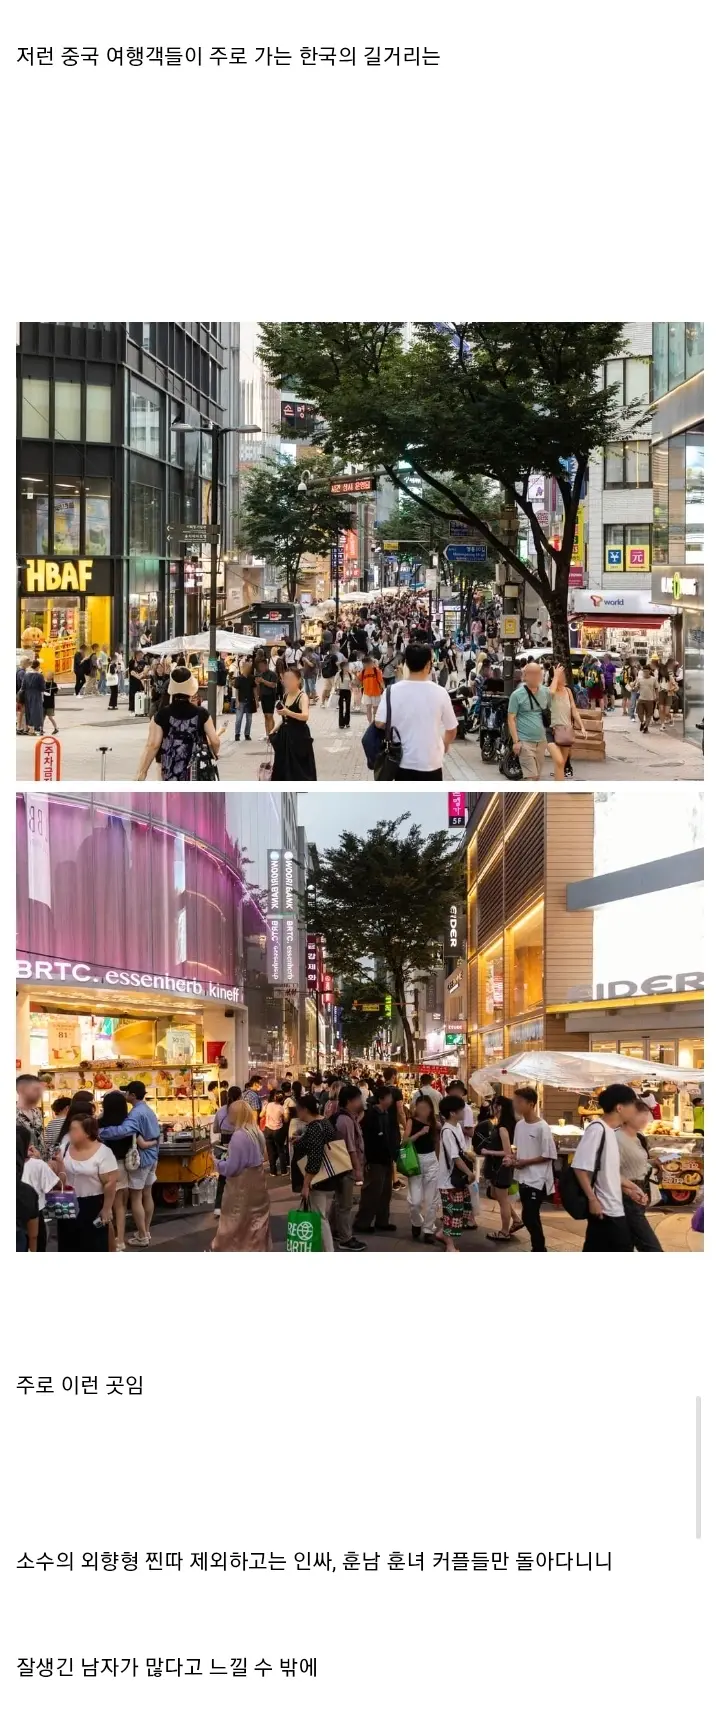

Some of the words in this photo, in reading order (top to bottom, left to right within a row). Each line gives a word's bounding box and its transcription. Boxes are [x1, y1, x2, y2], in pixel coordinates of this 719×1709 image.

[632, 551, 643, 562] 元
[26, 559, 93, 592] HBAF
[452, 817, 462, 825] 5F
[449, 905, 457, 948] EIDER
[105, 969, 202, 995] essenherb
[209, 981, 240, 1002] kineff
[567, 971, 704, 1003] EIDER
